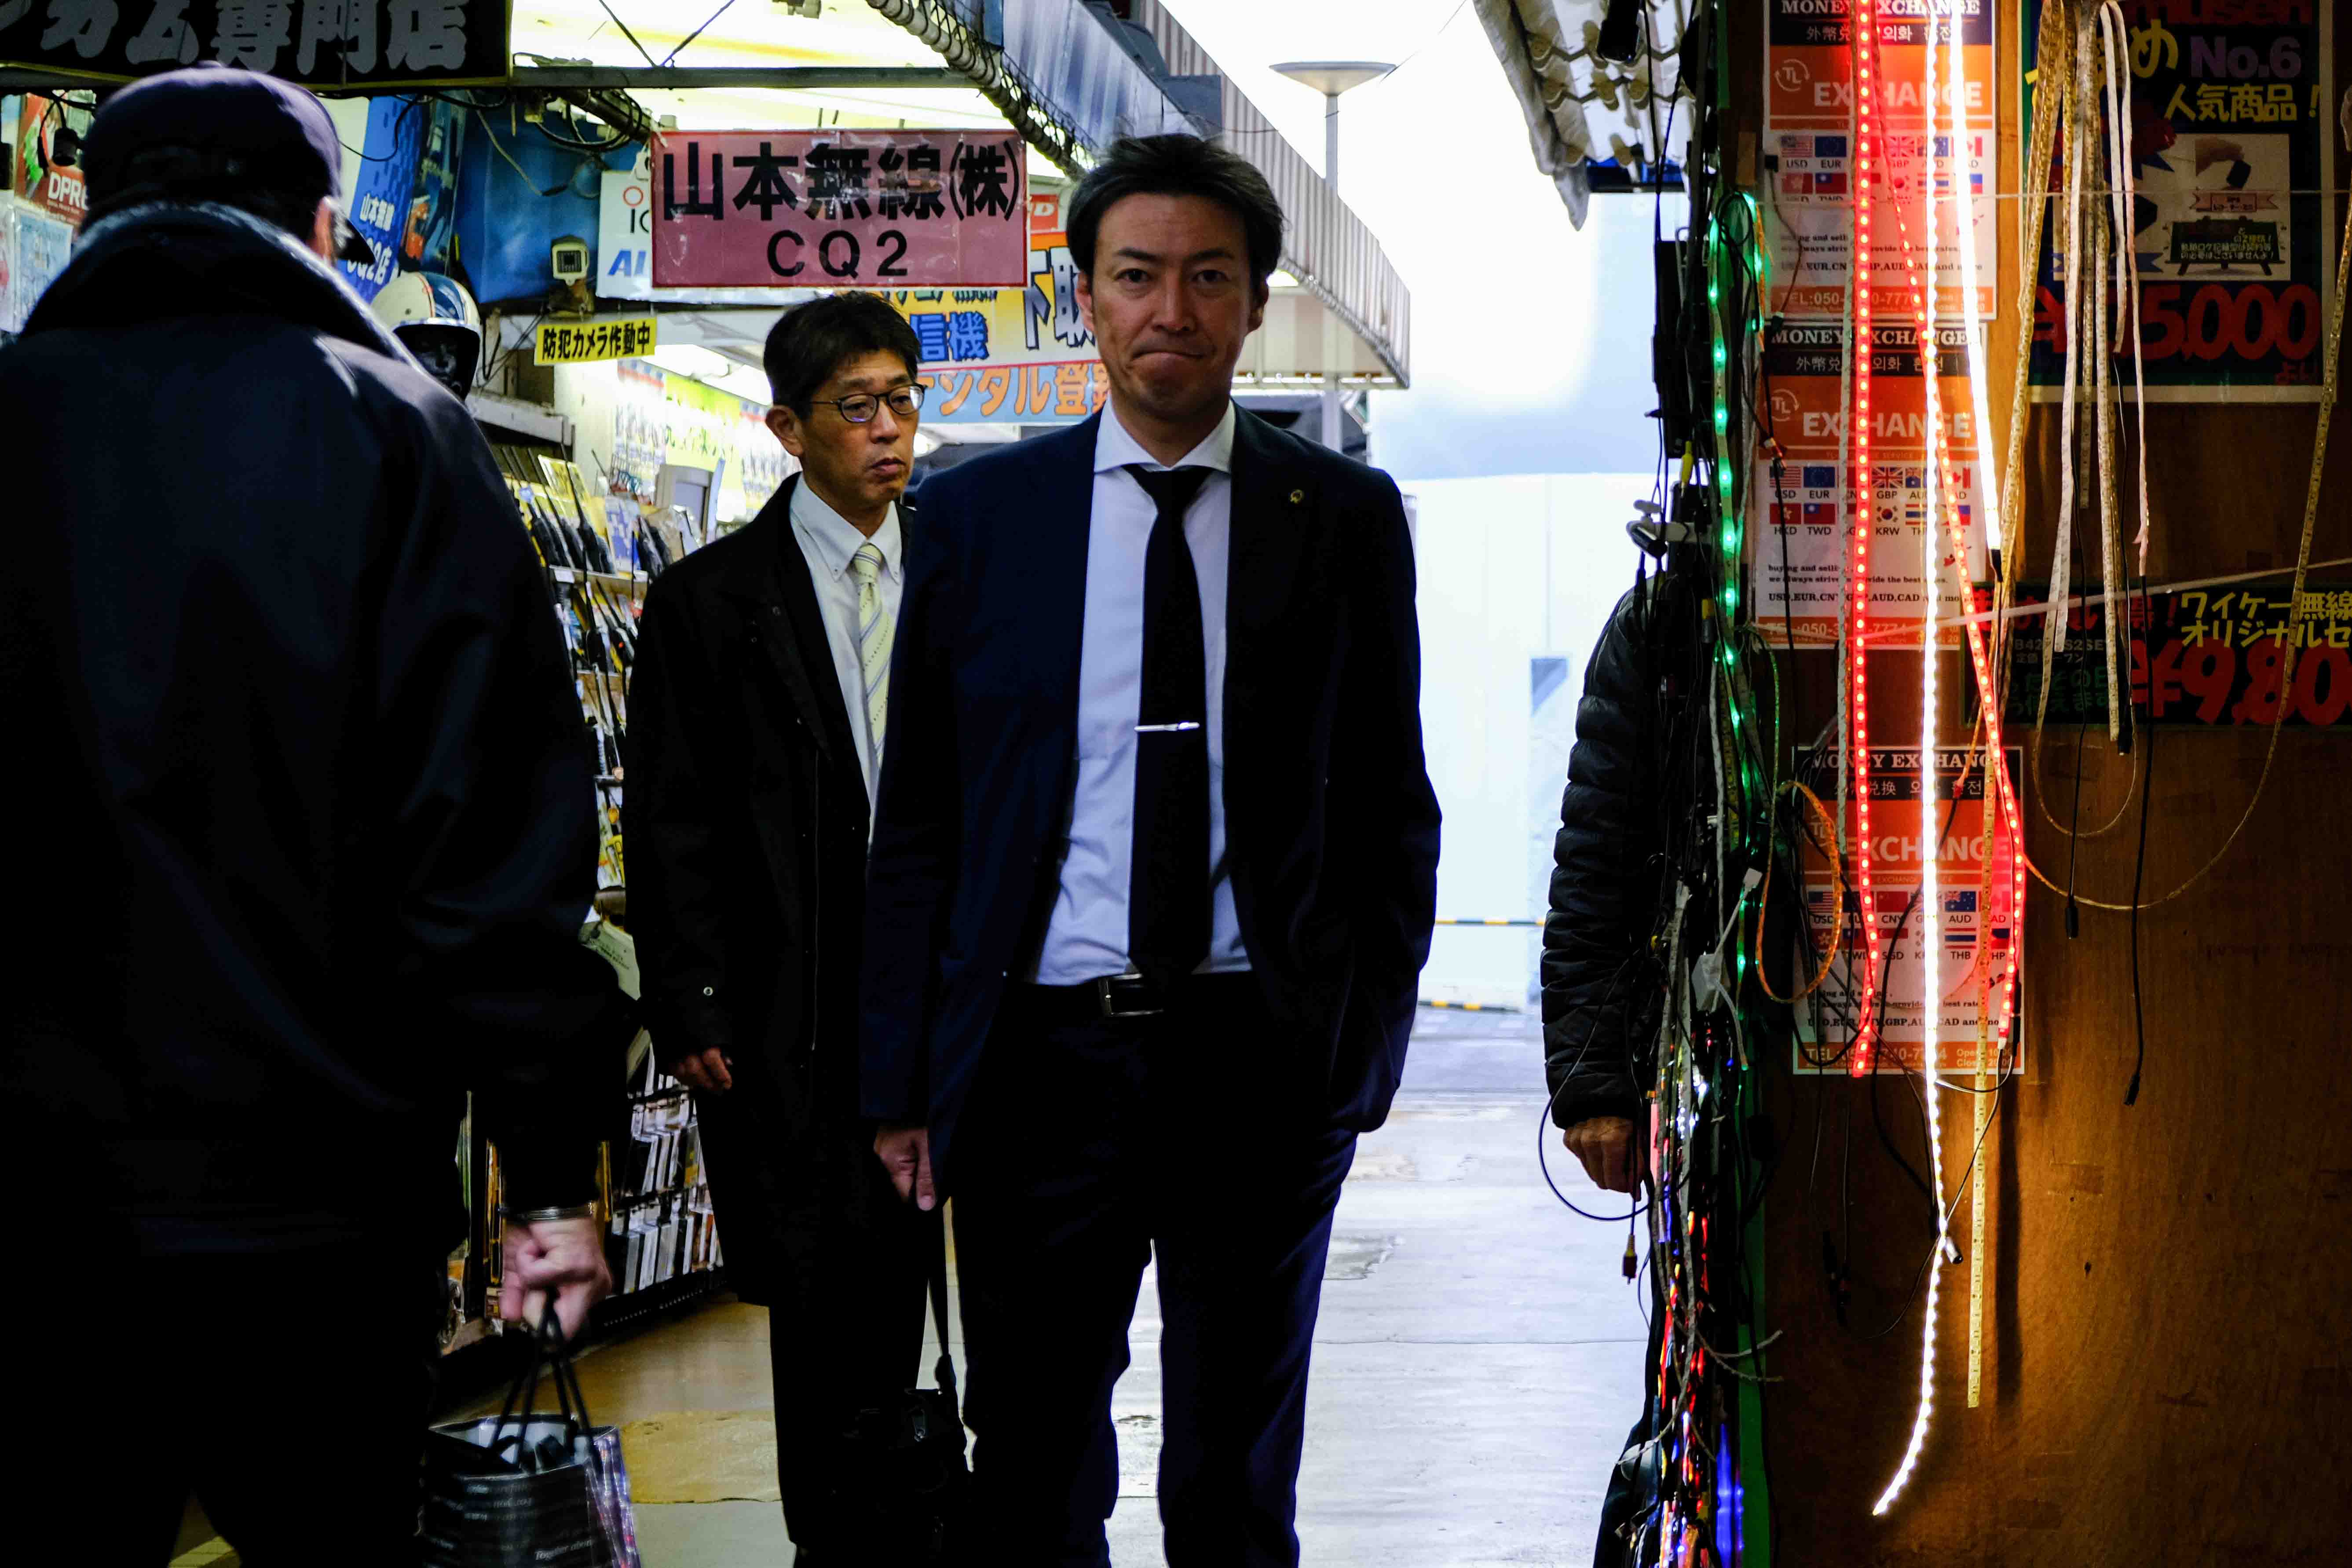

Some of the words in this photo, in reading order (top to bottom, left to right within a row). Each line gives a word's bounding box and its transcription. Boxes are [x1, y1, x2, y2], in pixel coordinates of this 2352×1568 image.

[2189, 36, 2302, 79] No.6
[1821, 160, 1841, 168] EUR
[663, 139, 1020, 222] 山本無線(株)
[542, 321, 651, 361] 防犯カメラ作動中
[1810, 490, 1830, 499] EUR
[1876, 490, 1897, 499] GBP
[1807, 526, 1832, 535] TWD
[1876, 527, 1900, 535] KRW
[1990, 915, 2006, 923] AD
[1950, 951, 1971, 960] THB
